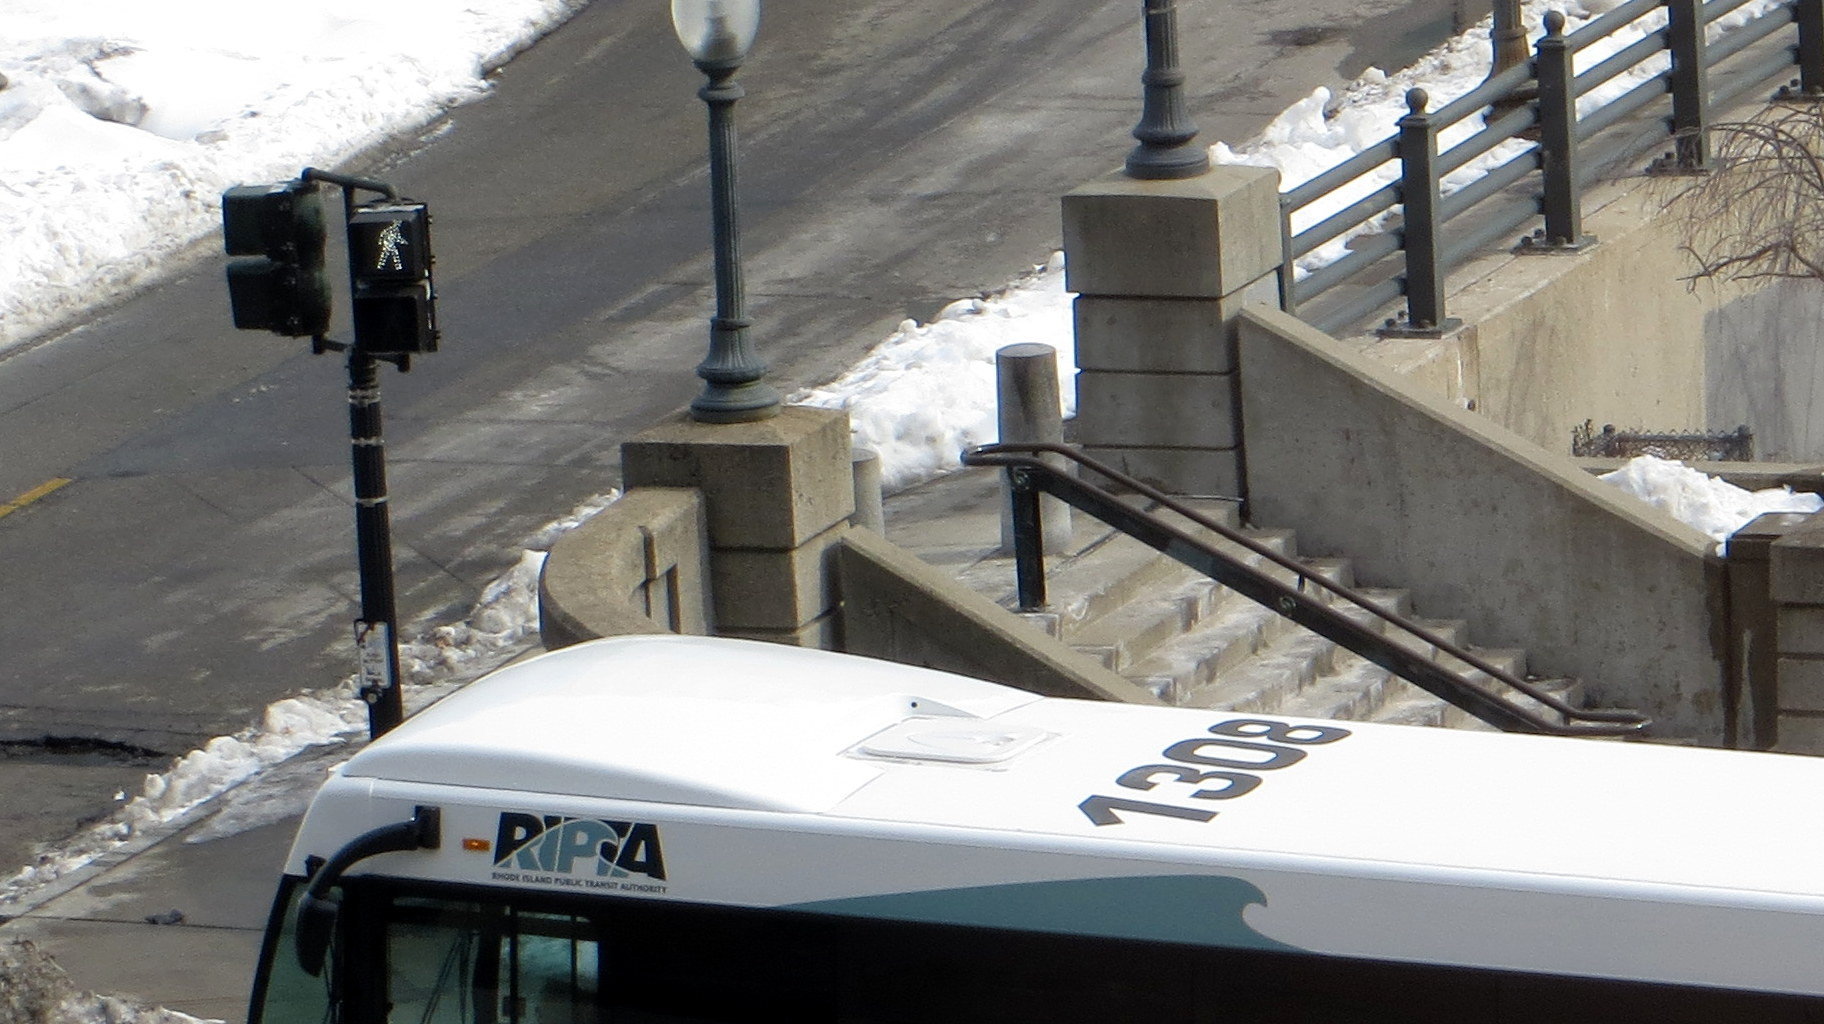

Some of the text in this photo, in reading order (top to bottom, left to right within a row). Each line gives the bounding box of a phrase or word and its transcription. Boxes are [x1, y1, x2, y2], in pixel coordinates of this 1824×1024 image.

[1078, 718, 1353, 827] 1308
[494, 811, 667, 881] RIPTA
[492, 872, 667, 893] RHODE ISLAND PUBLIC TRANSIT AUTHORITY
